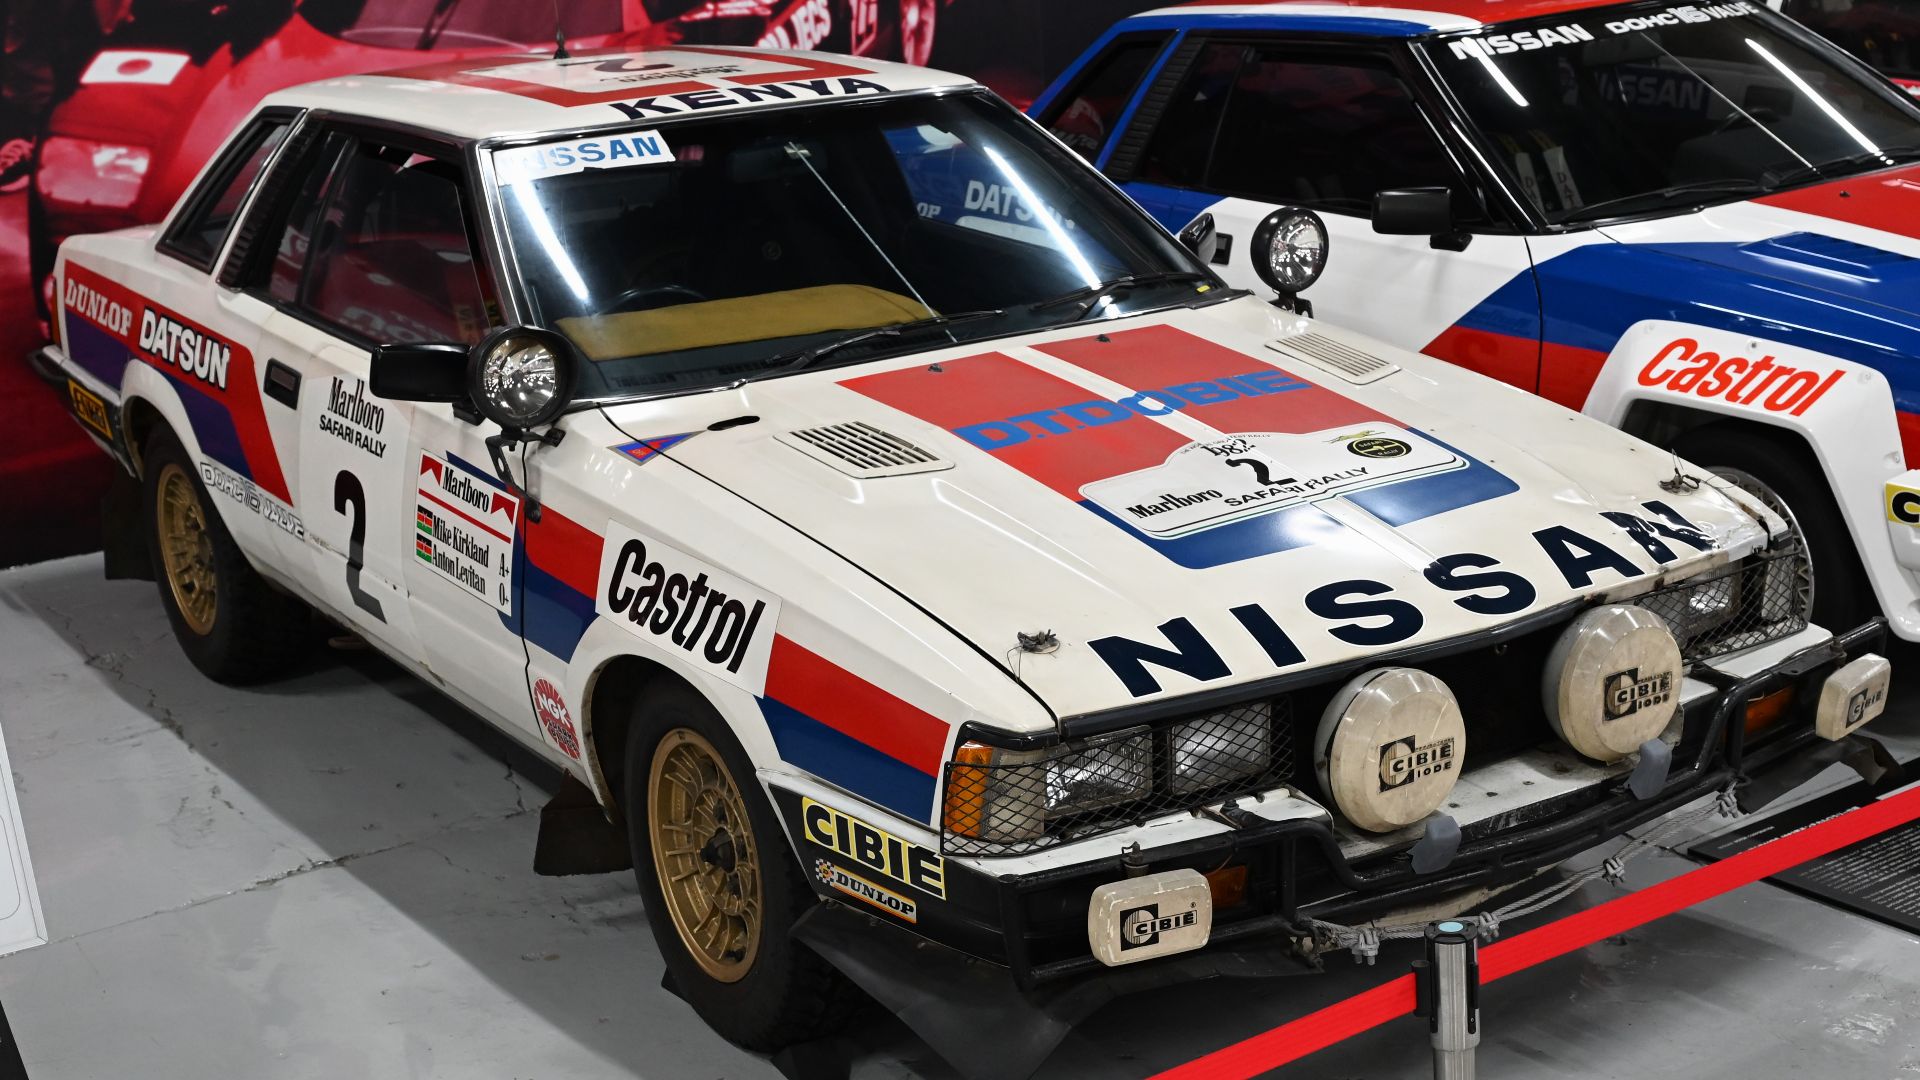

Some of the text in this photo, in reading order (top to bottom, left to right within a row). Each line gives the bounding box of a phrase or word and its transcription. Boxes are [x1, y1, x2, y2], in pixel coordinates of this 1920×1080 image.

[1448, 23, 1595, 59] NISSAN
[609, 78, 890, 120] KENYA
[512, 136, 662, 170] ISSAN
[65, 278, 132, 337] DUNLOP
[139, 307, 230, 389] DATSUN
[1637, 338, 1846, 417] Castrol
[327, 376, 385, 434] Marlboro
[319, 414, 386, 458] SAFARI RALLY
[443, 466, 490, 513] Marlboro
[1126, 466, 1370, 520] Marlboro SAFARI RALLY
[1225, 458, 1298, 486] 2
[334, 469, 388, 625] 2
[432, 515, 510, 578] Mike Kirkland A+
[432, 543, 455, 577] Anton
[455, 556, 486, 596] Levitan
[608, 538, 767, 673] Castrol
[1088, 500, 1718, 698] NISSAN
[537, 690, 571, 729] NGK
[1417, 761, 1452, 778] IODE
[836, 871, 915, 915] DUNLOP
